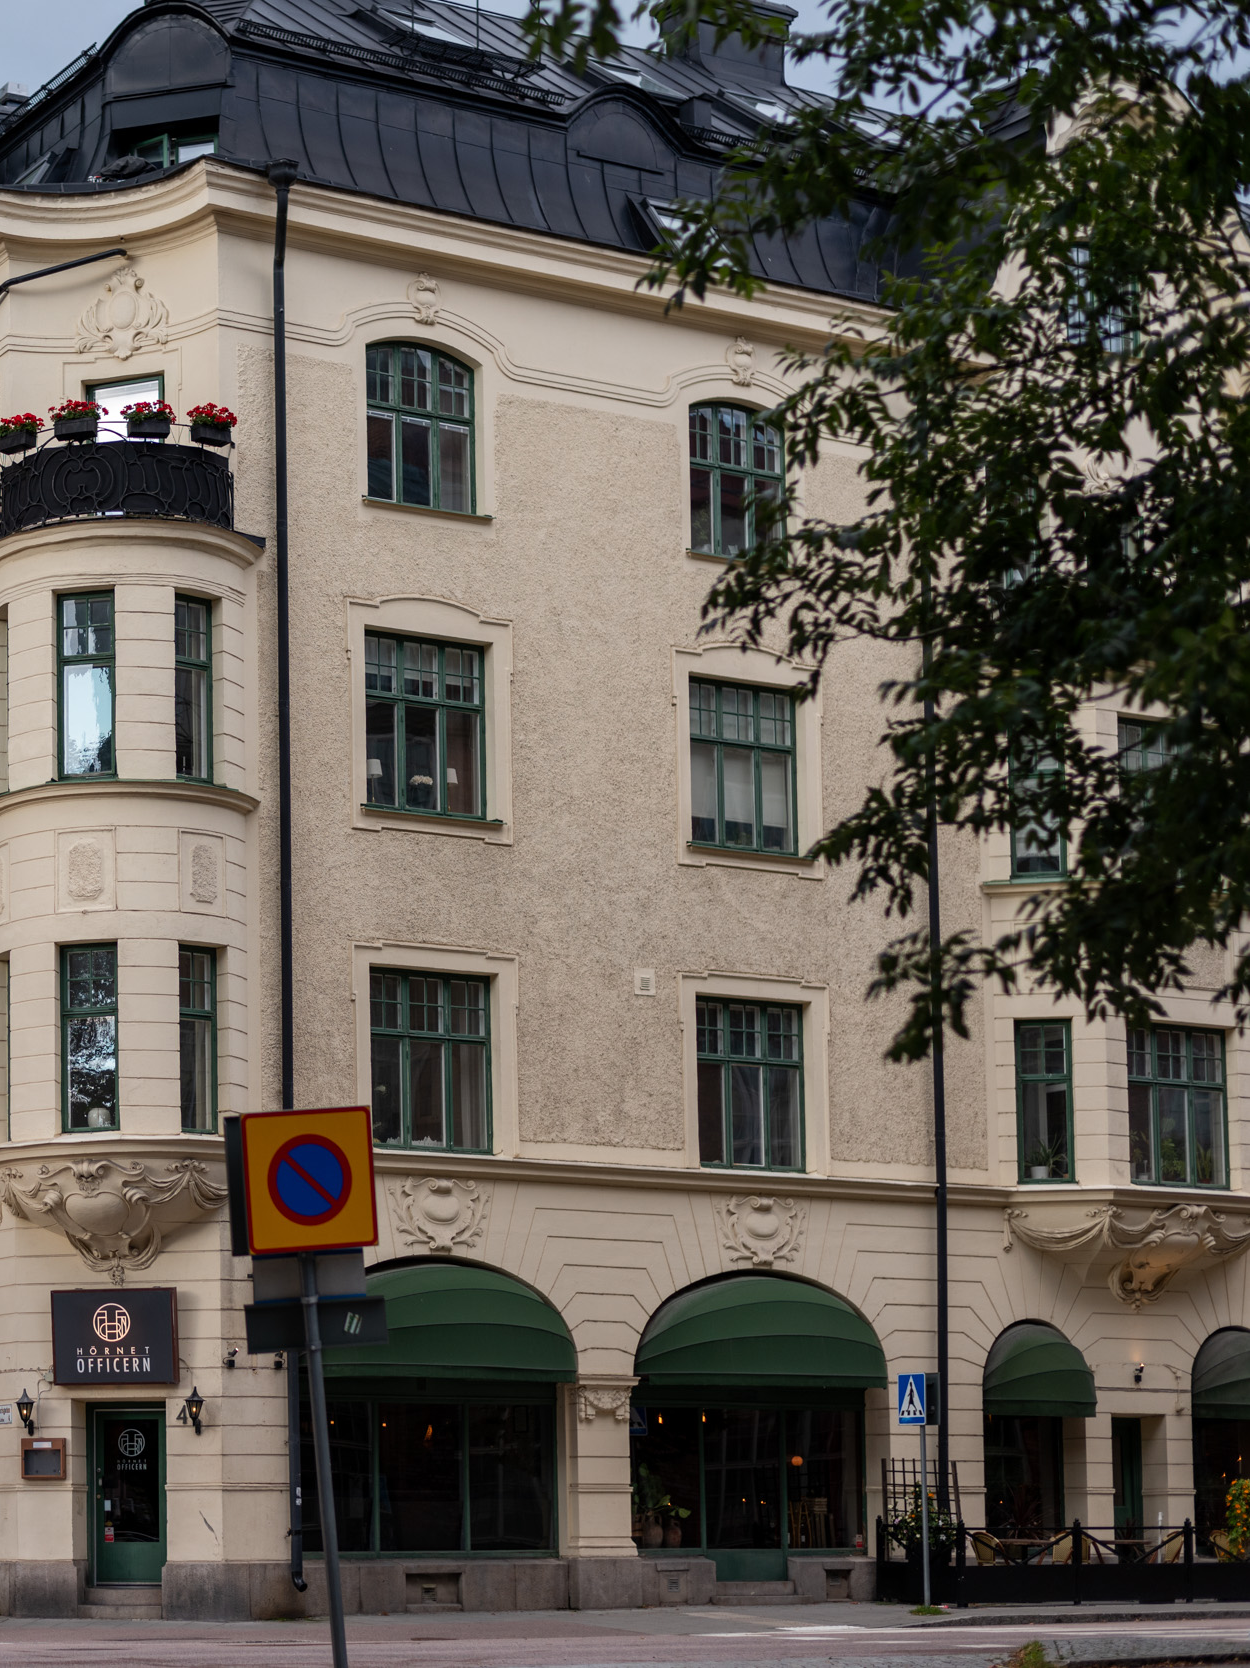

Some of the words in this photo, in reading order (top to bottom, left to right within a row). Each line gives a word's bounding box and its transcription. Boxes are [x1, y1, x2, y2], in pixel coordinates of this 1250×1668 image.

[76, 1357, 151, 1373] OFFICERN
[176, 1404, 188, 1425] 4
[116, 1463, 148, 1471] OFFICERN
